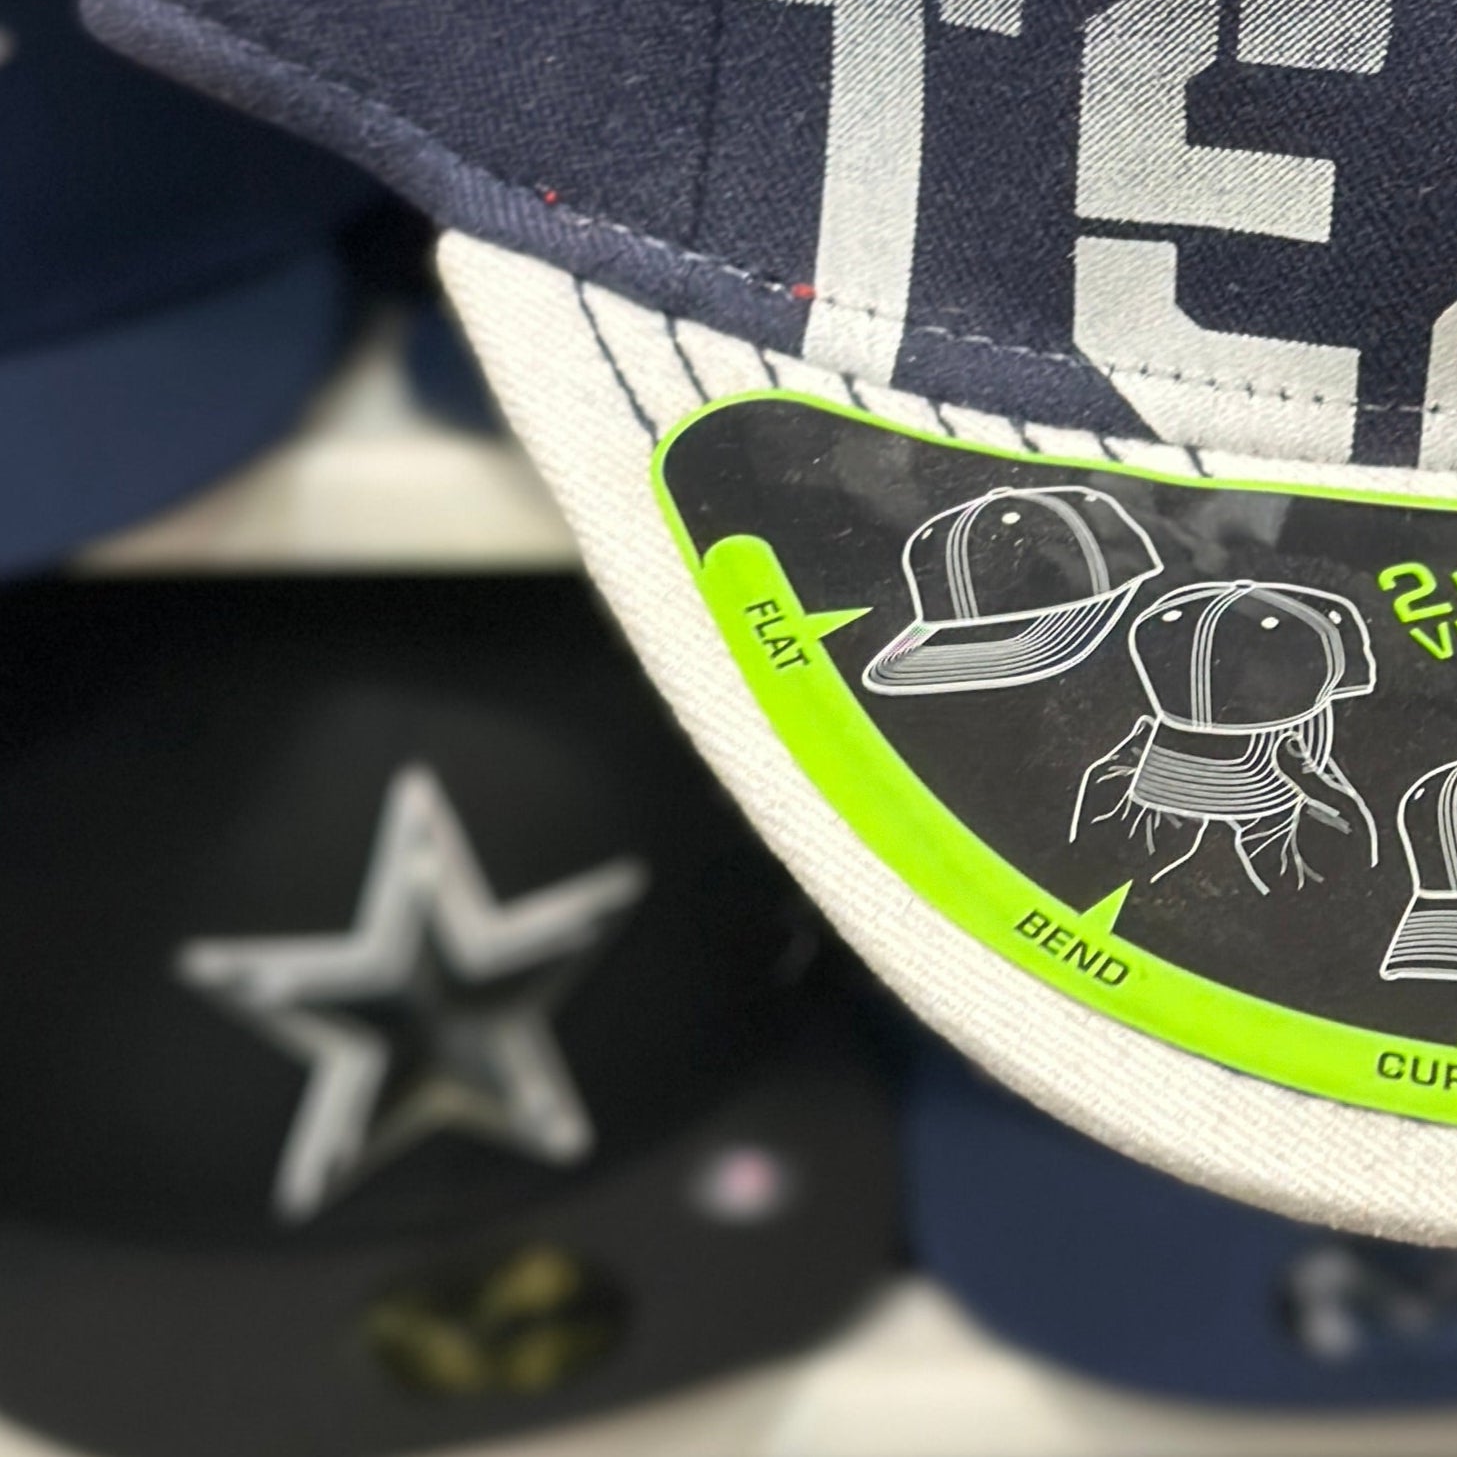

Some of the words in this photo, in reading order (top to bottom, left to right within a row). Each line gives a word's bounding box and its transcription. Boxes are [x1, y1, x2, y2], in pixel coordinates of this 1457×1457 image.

[1378, 562, 1453, 624] 2
[745, 598, 810, 672] FLAT
[1013, 908, 1131, 986] BEND
